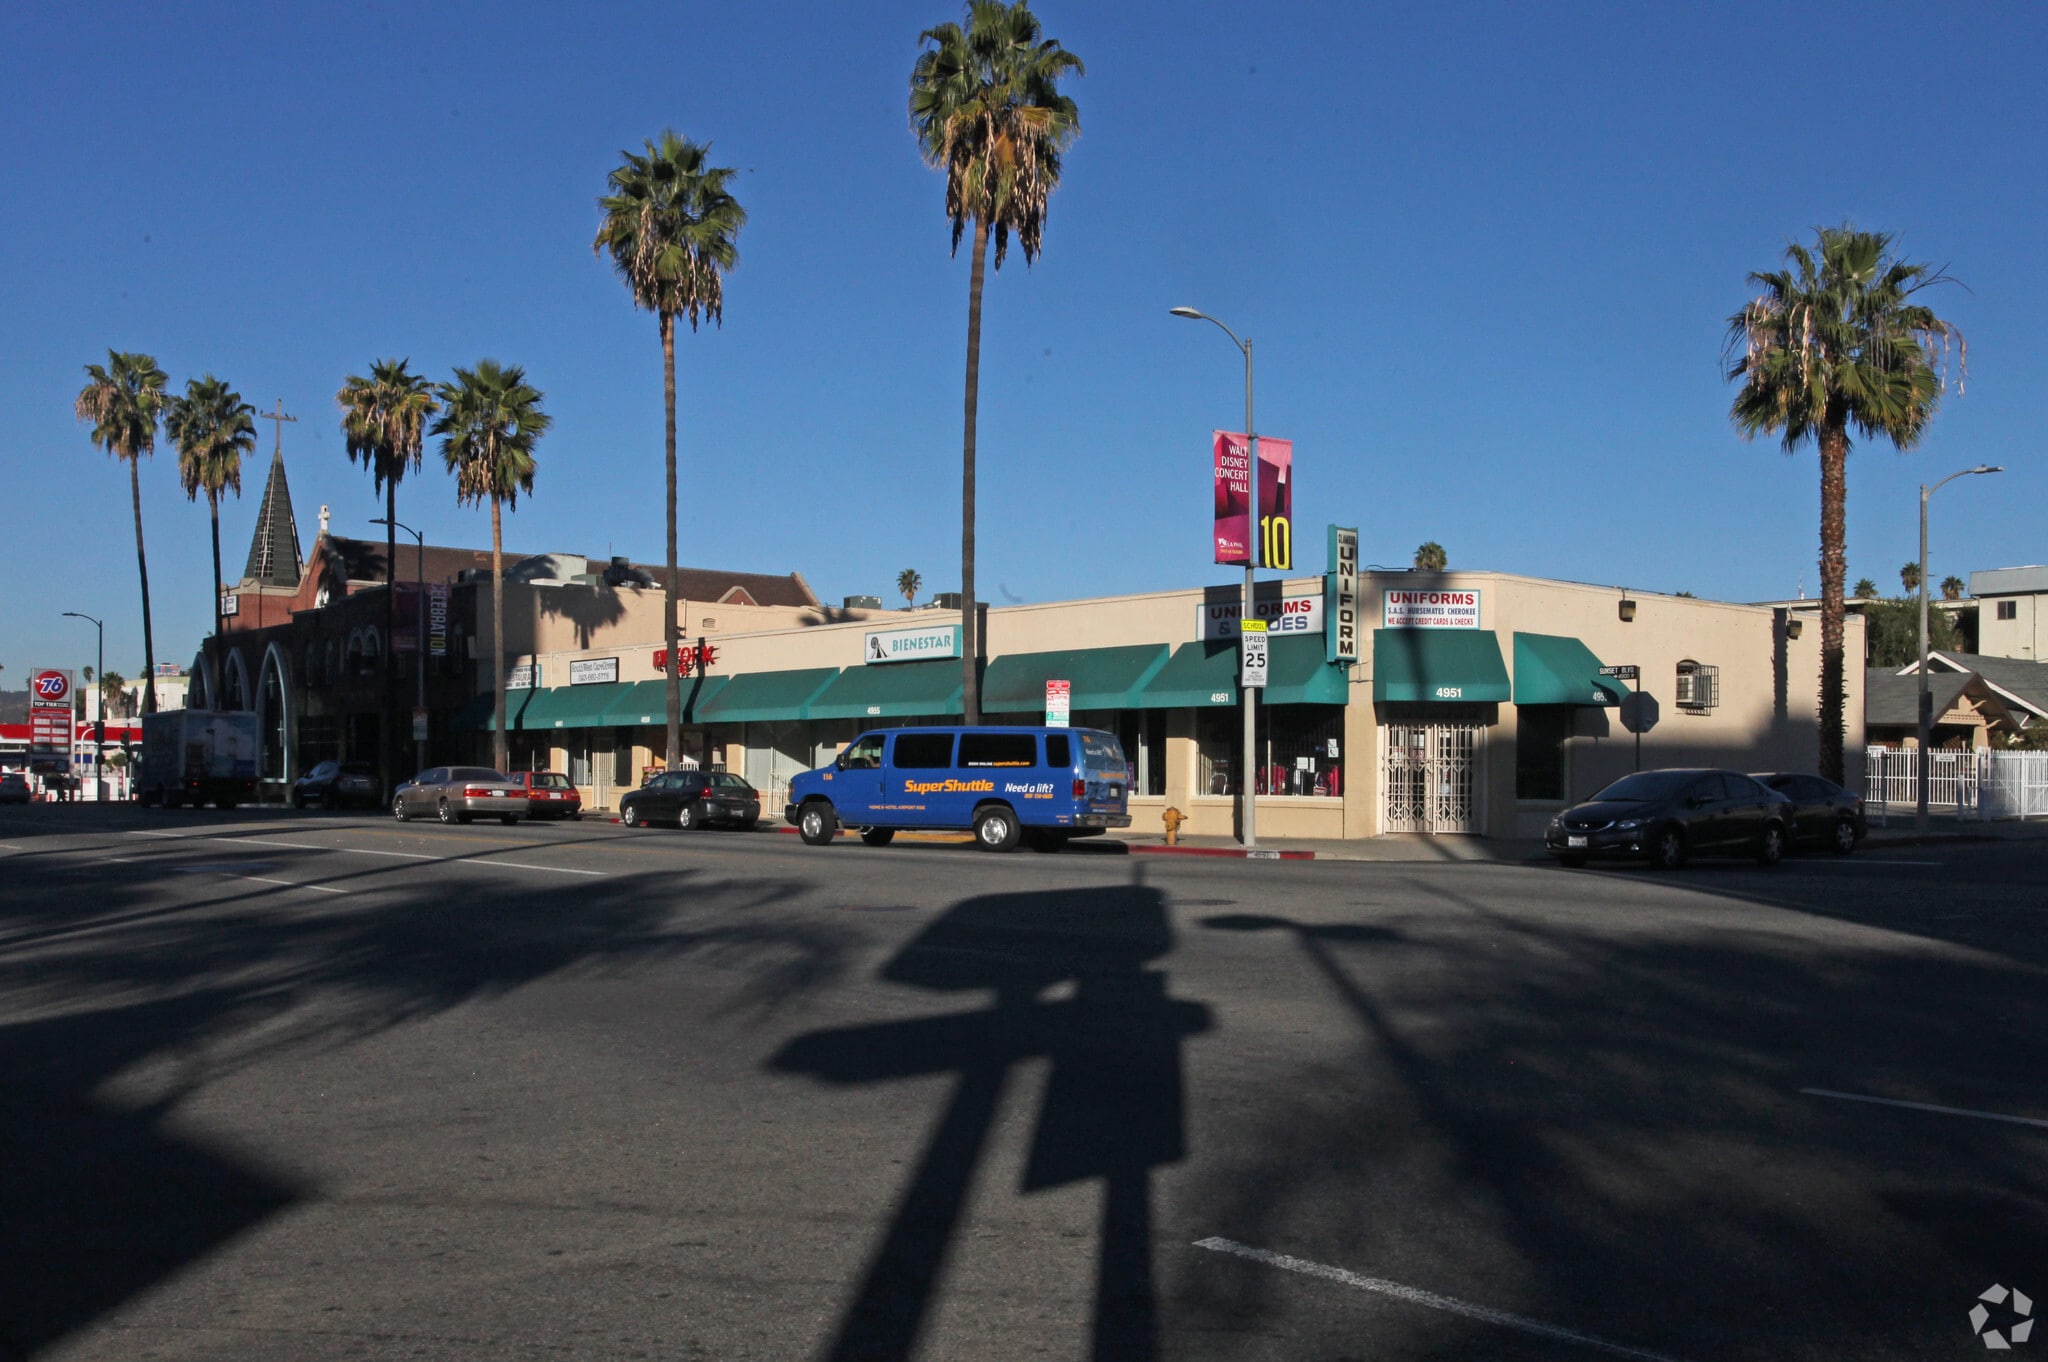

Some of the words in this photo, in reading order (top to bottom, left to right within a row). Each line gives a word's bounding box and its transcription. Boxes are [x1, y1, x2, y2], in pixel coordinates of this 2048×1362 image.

[1229, 445, 1248, 456] WALT
[1221, 456, 1248, 468] DISNEY
[1214, 467, 1248, 480] CONCERT
[1230, 481, 1248, 493] HALL
[1260, 515, 1290, 570] 10
[1340, 546, 1354, 655] UNIFORM
[1390, 592, 1474, 605] UNIFORMS
[1211, 600, 1312, 619] UNIORMS
[1407, 607, 1445, 615] NURSEMATES
[1243, 622, 1265, 630] SCHOOL
[1267, 615, 1308, 632] OES
[1388, 617, 1395, 625] WE
[1396, 617, 1414, 625] ACCEPT
[1415, 617, 1432, 625] CREDIT
[1433, 617, 1449, 625] CARDS
[892, 635, 951, 652] BIENESTAR
[1245, 635, 1266, 643] SPEED
[1246, 652, 1266, 668] 25
[1599, 667, 1618, 675] SUNSET
[1621, 666, 1635, 674] BLVD
[39, 676, 64, 694] 76
[1211, 693, 1229, 703] 4951
[1436, 687, 1462, 698] 4951
[1593, 691, 1607, 702] 495
[823, 773, 833, 781] 116
[904, 779, 994, 795] SuperShuttle
[1005, 782, 1029, 793] Need
[1029, 785, 1035, 793] a
[1036, 783, 1054, 793] lift?
